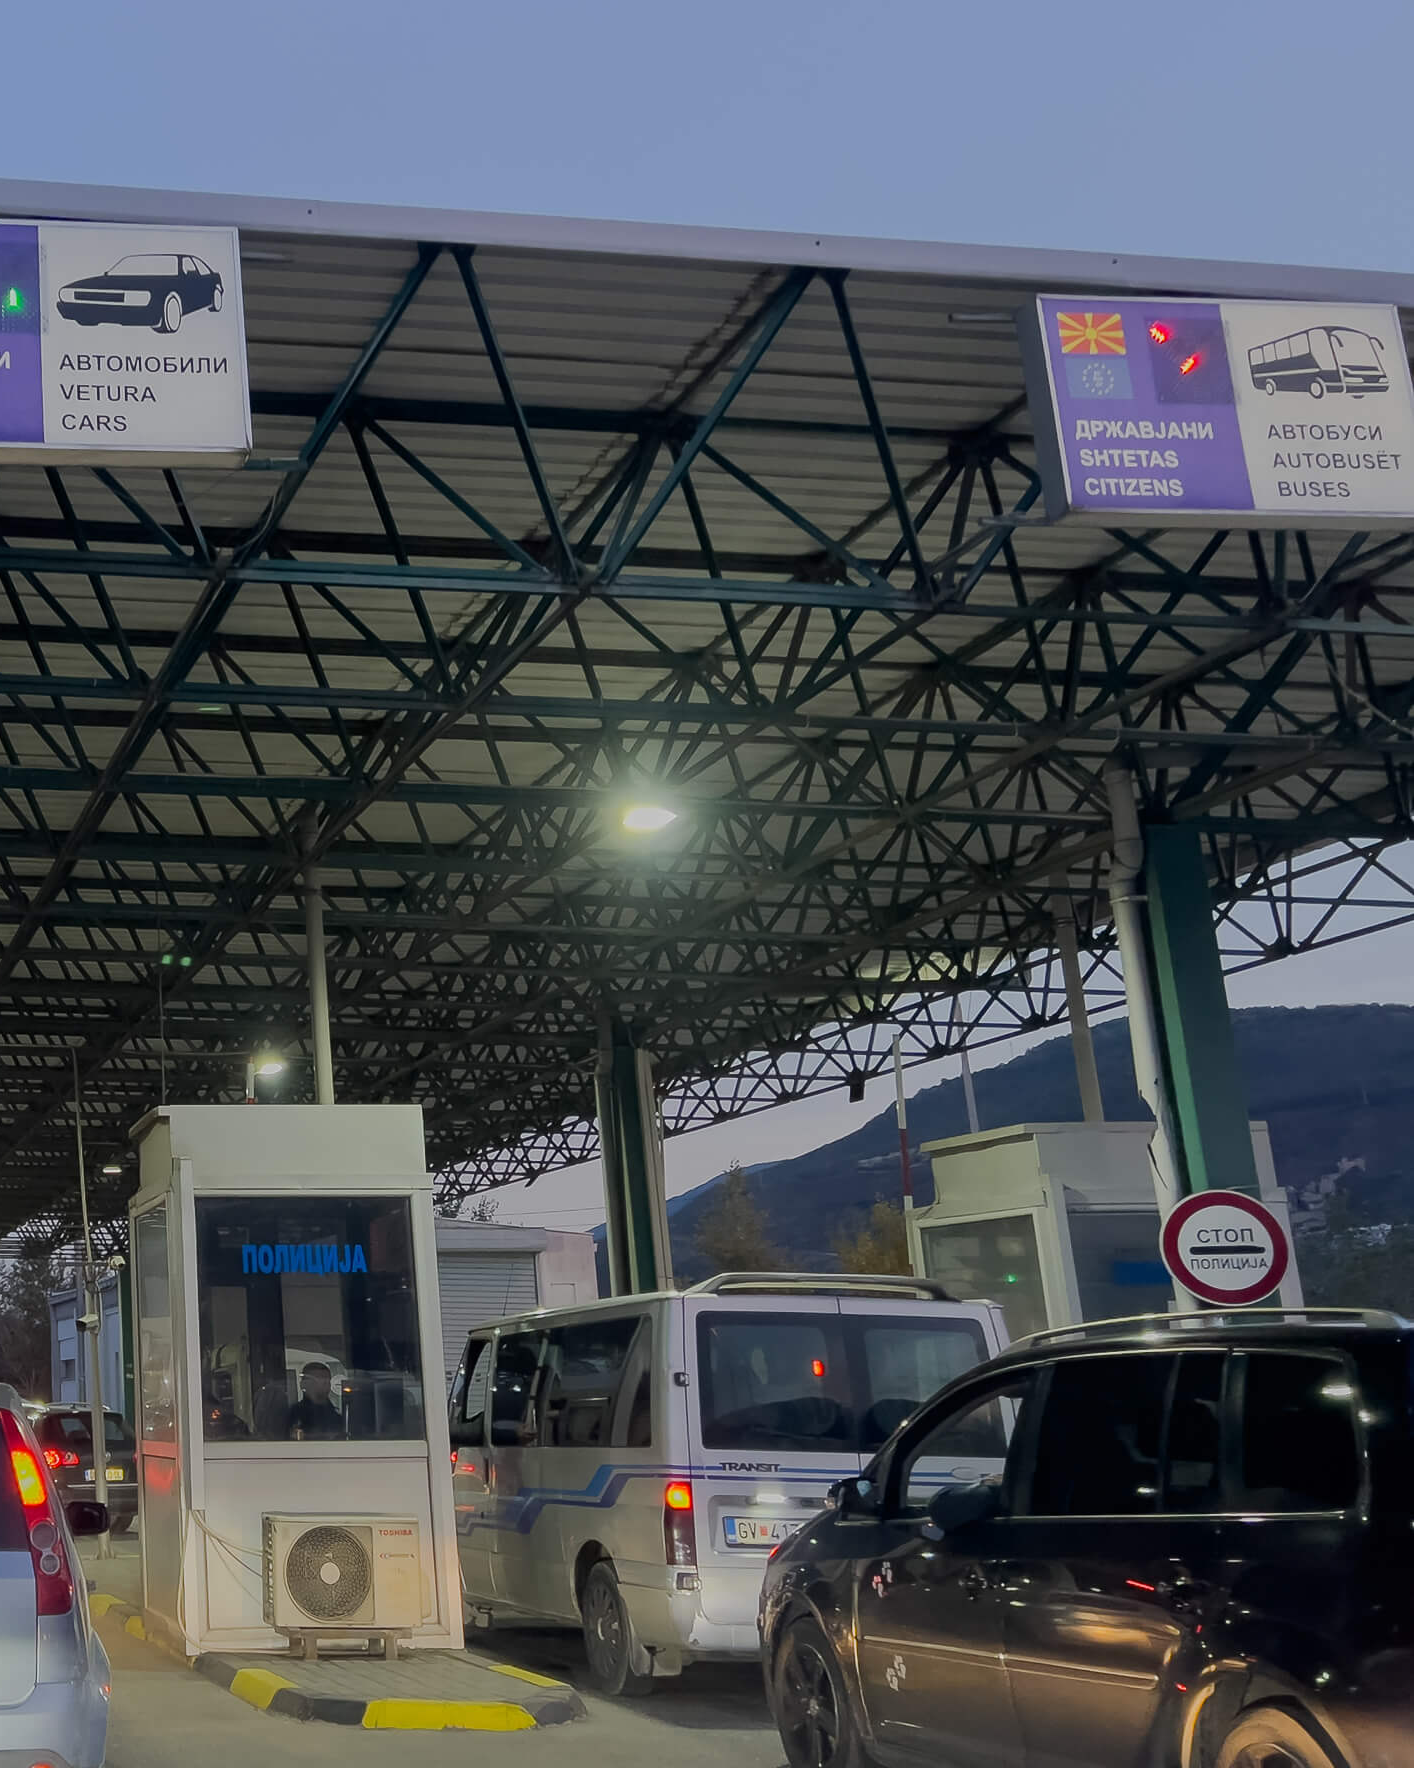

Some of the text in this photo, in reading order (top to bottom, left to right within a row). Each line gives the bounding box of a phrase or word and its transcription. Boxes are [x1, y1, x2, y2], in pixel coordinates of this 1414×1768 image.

[59, 354, 229, 375] АВТОМОБИЛИ
[60, 383, 157, 403] VETURA
[61, 413, 128, 432] CARS
[1075, 418, 1214, 441] ДРЖАВЈАНИ
[1267, 423, 1383, 442] АВТОБУСИ
[1080, 448, 1179, 469] SHTETAS
[1273, 452, 1402, 470] AUTOBUSËT
[1084, 477, 1184, 498] CITIZENS
[1278, 480, 1351, 498] BUSES
[1196, 1228, 1254, 1244] СТОП
[241, 1244, 368, 1276] ПОЛИЦИЈА
[1190, 1258, 1268, 1270] ПОЛИЦИЈА
[719, 1462, 780, 1472] TRANSIT
[738, 1522, 757, 1540] GV
